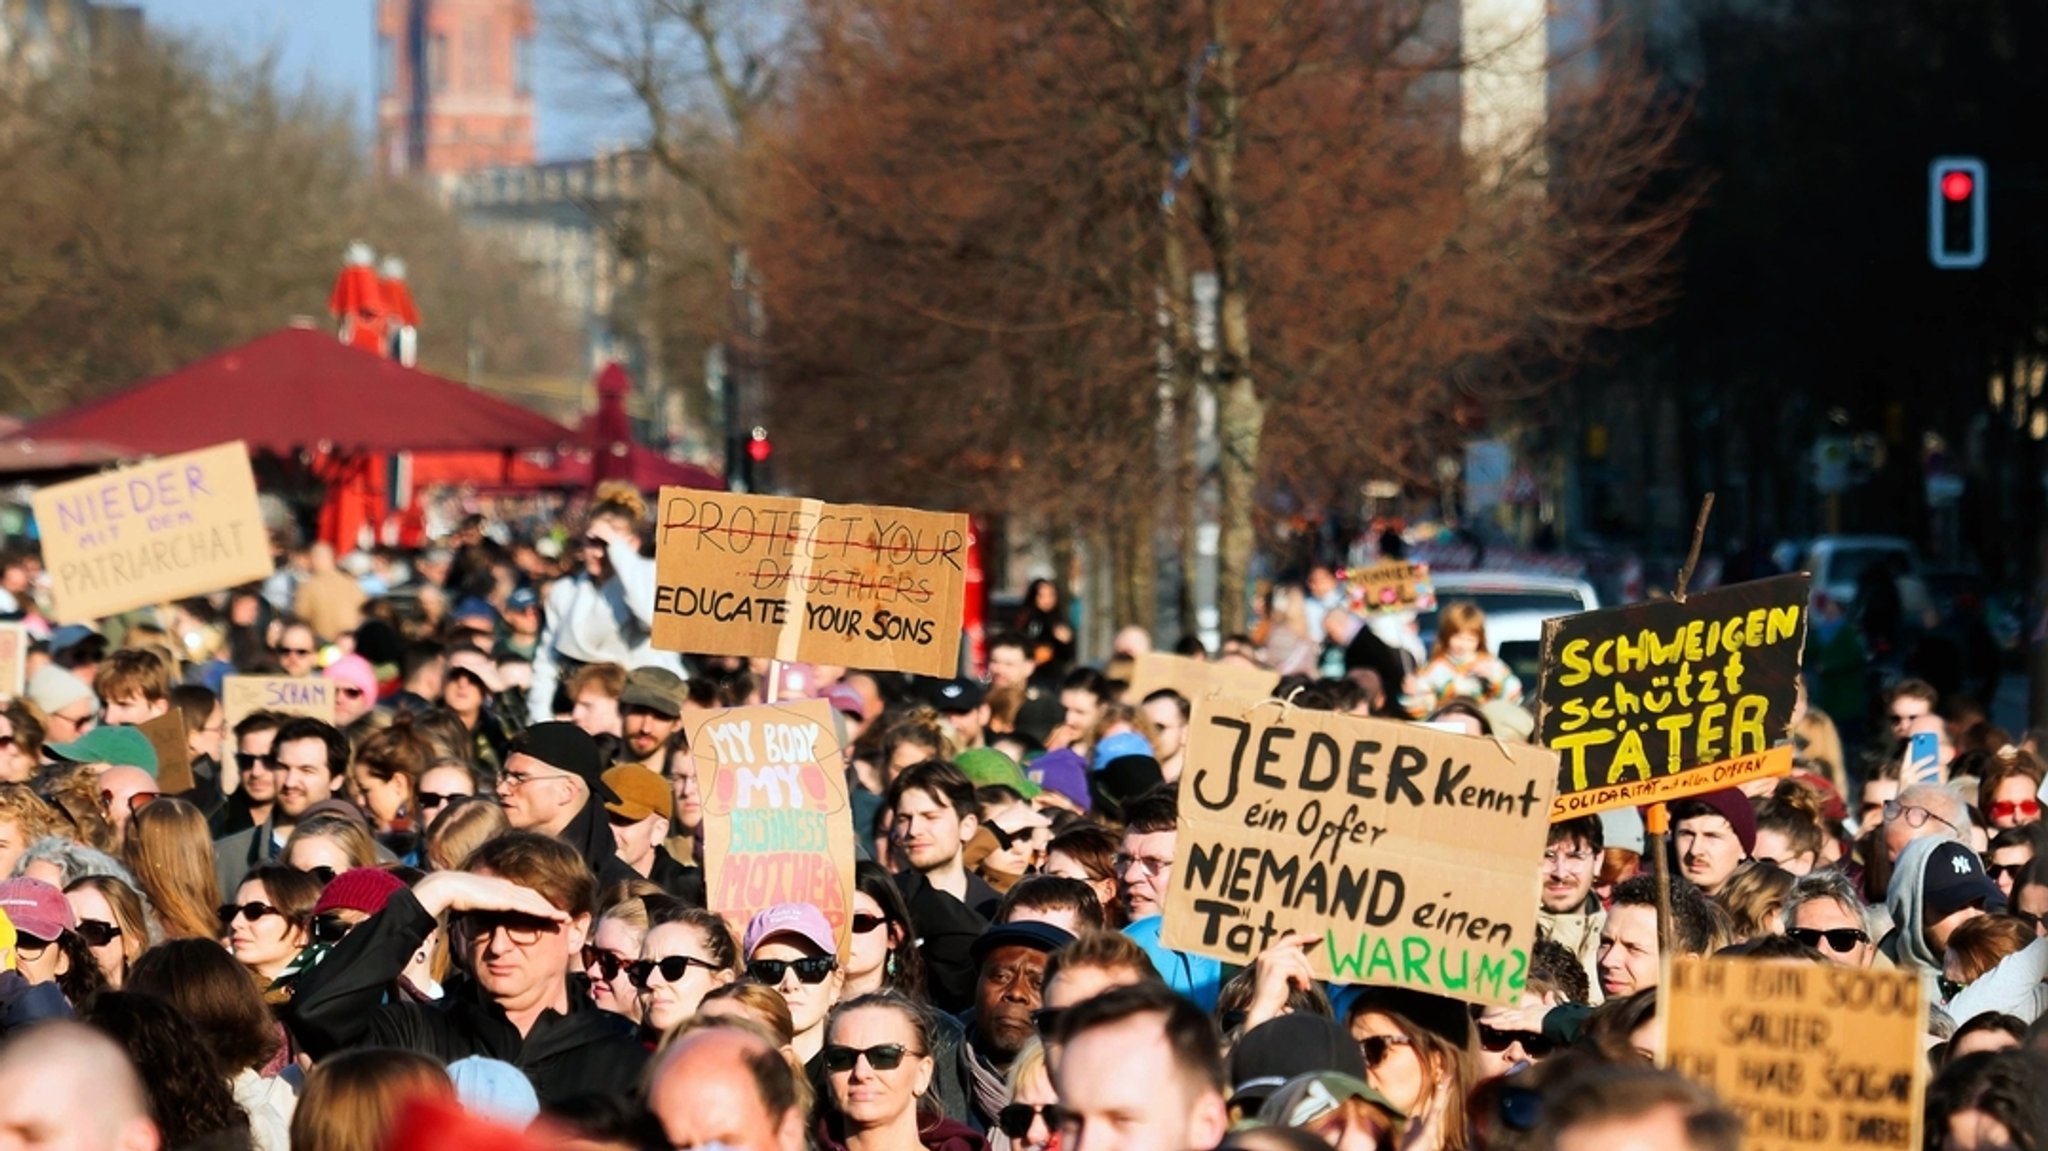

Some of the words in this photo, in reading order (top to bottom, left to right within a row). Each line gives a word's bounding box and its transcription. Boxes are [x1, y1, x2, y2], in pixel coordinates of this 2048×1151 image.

[56, 464, 212, 533] NIEDER
[58, 521, 245, 596] PATRIARCHAT
[79, 525, 120, 549] MIT
[147, 510, 193, 532] DEM
[663, 497, 862, 560] PROTECT
[873, 518, 963, 571] YOUR
[752, 558, 933, 604] DAUGTHERS
[653, 585, 791, 625] EDUCATE
[805, 601, 862, 637] YOUR
[865, 610, 936, 645] SONS
[1558, 605, 1799, 687] SCHWEIGEN
[264, 681, 327, 706] SCHAM
[1559, 651, 1745, 731] schützt
[706, 719, 755, 764] MY
[763, 721, 820, 763] BODY
[1193, 716, 1430, 811] JEDER
[1550, 694, 1770, 792] TÄTER
[735, 763, 804, 809] MY
[1551, 779, 1660, 816] SOLIDARITÄT
[728, 808, 829, 854] BUSINESS
[1243, 797, 1289, 832] ein
[1295, 799, 1388, 865] Opfer
[714, 851, 843, 910] MOTHER
[1184, 842, 1406, 928] NIEMAND
[1412, 891, 1513, 949] einen
[1194, 898, 1322, 956] Tät
[1326, 928, 1528, 1003] WARUM?
[1669, 960, 1727, 996] ICH
[1737, 1054, 1807, 1098] HAB
